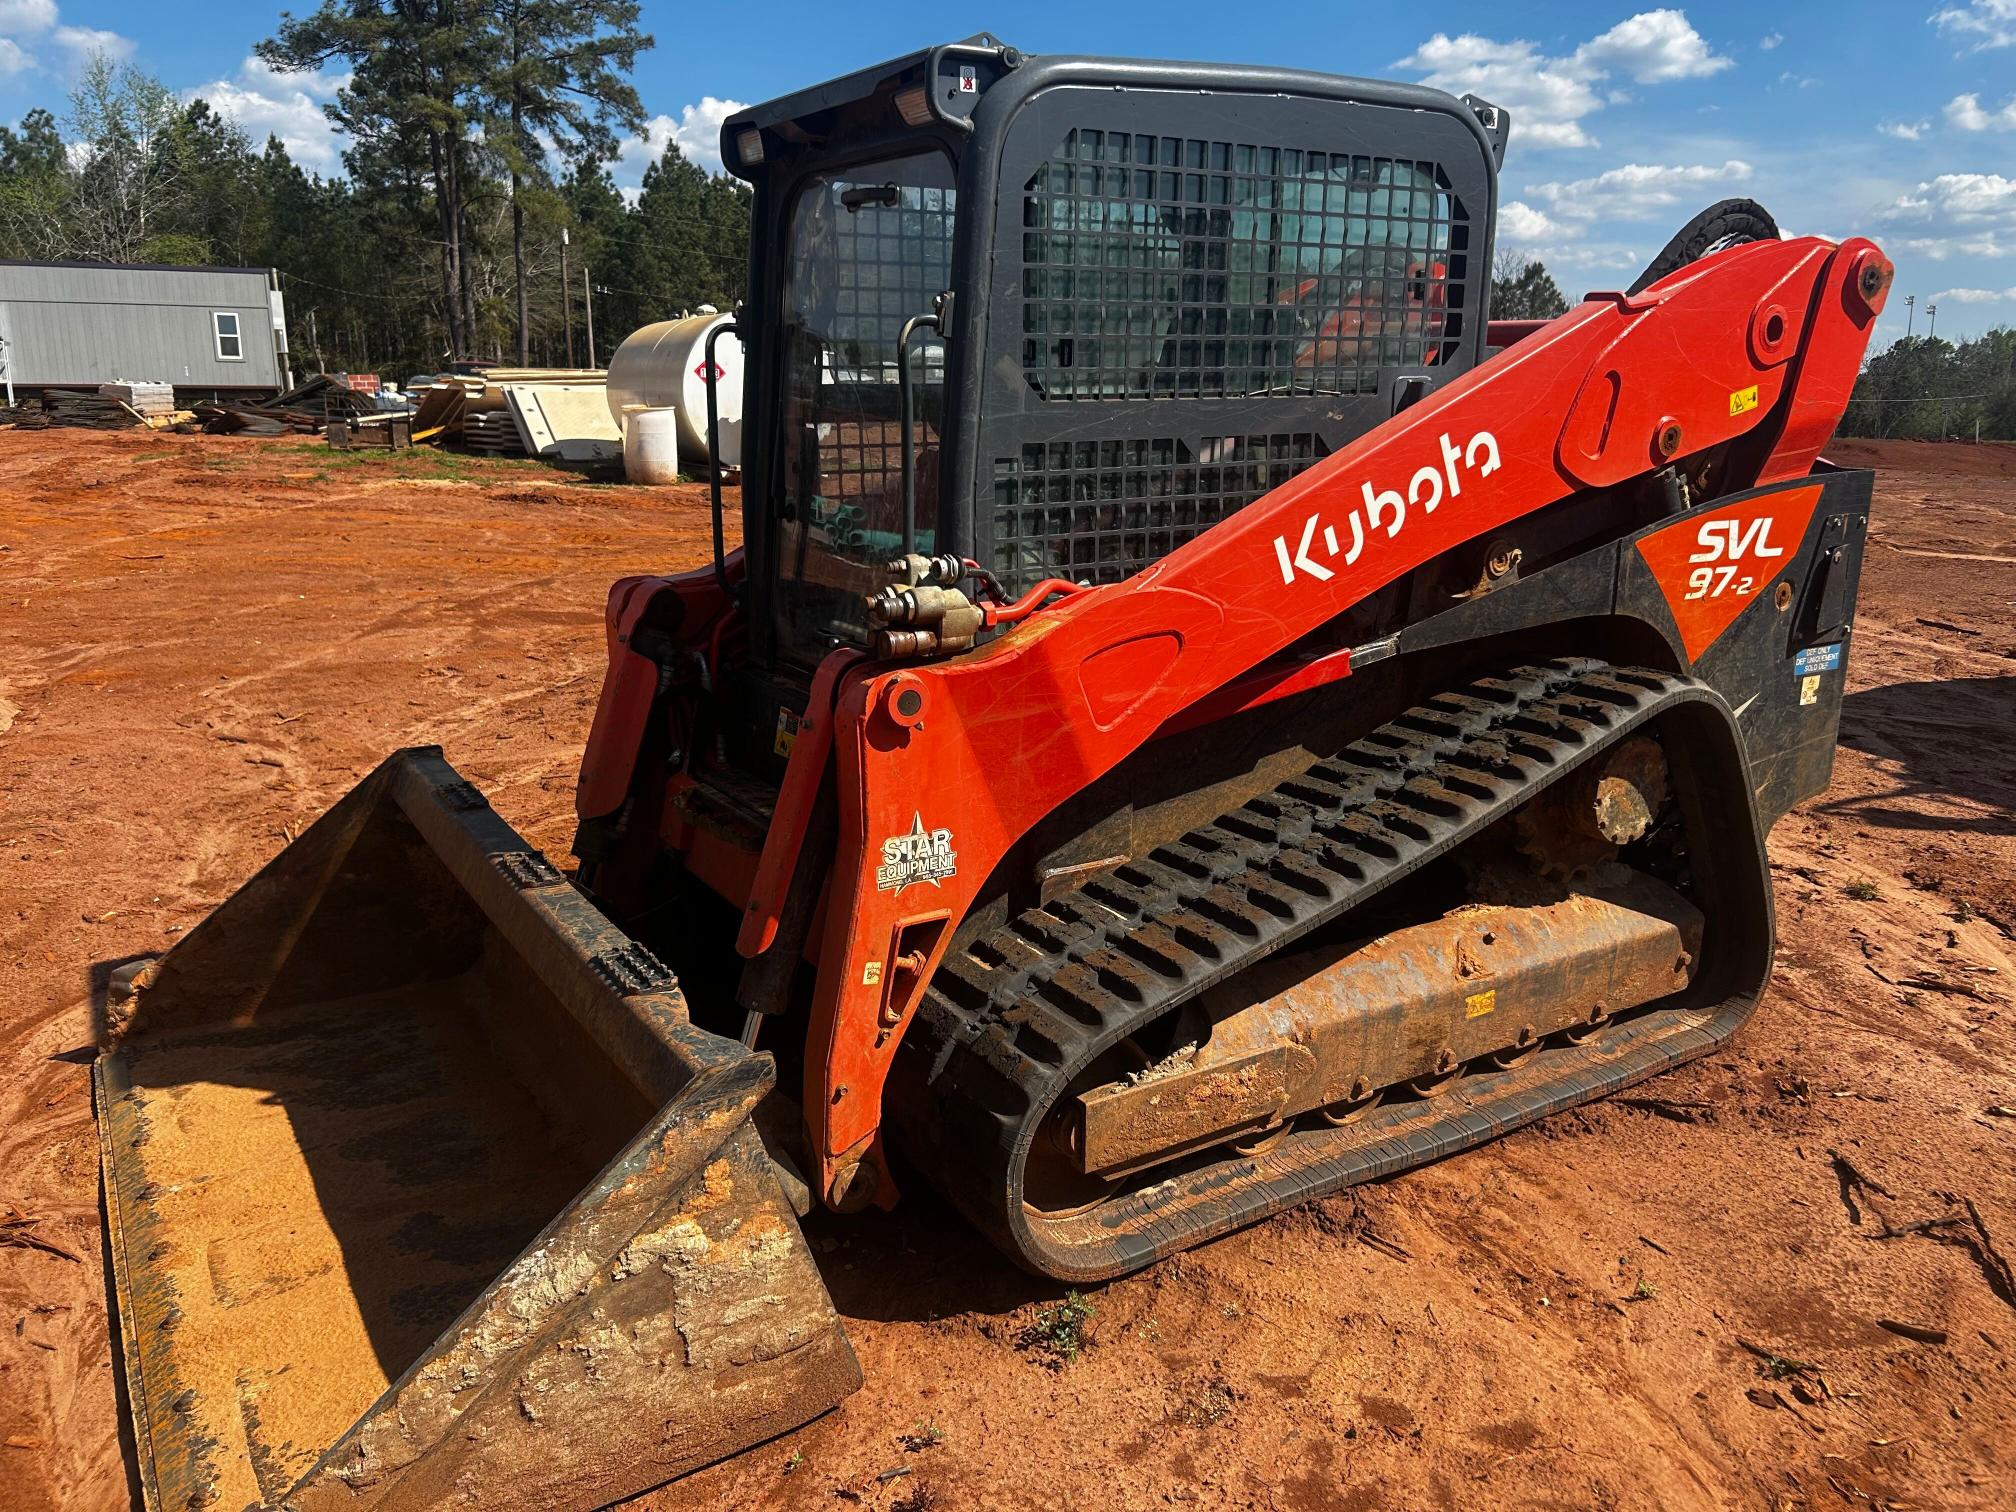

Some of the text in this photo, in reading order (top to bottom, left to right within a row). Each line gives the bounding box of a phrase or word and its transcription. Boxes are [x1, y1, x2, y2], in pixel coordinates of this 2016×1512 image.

[1273, 431, 1502, 585] Kubota
[1688, 517, 1784, 563] SVL
[1684, 565, 1753, 600] 97-2
[1795, 657, 1807, 666] DEF
[1804, 661, 1829, 672] SOLO DEF
[1806, 646, 1831, 656] DEF ONLY
[883, 829, 951, 865] STAR
[877, 852, 956, 881] EQUIPMENT
